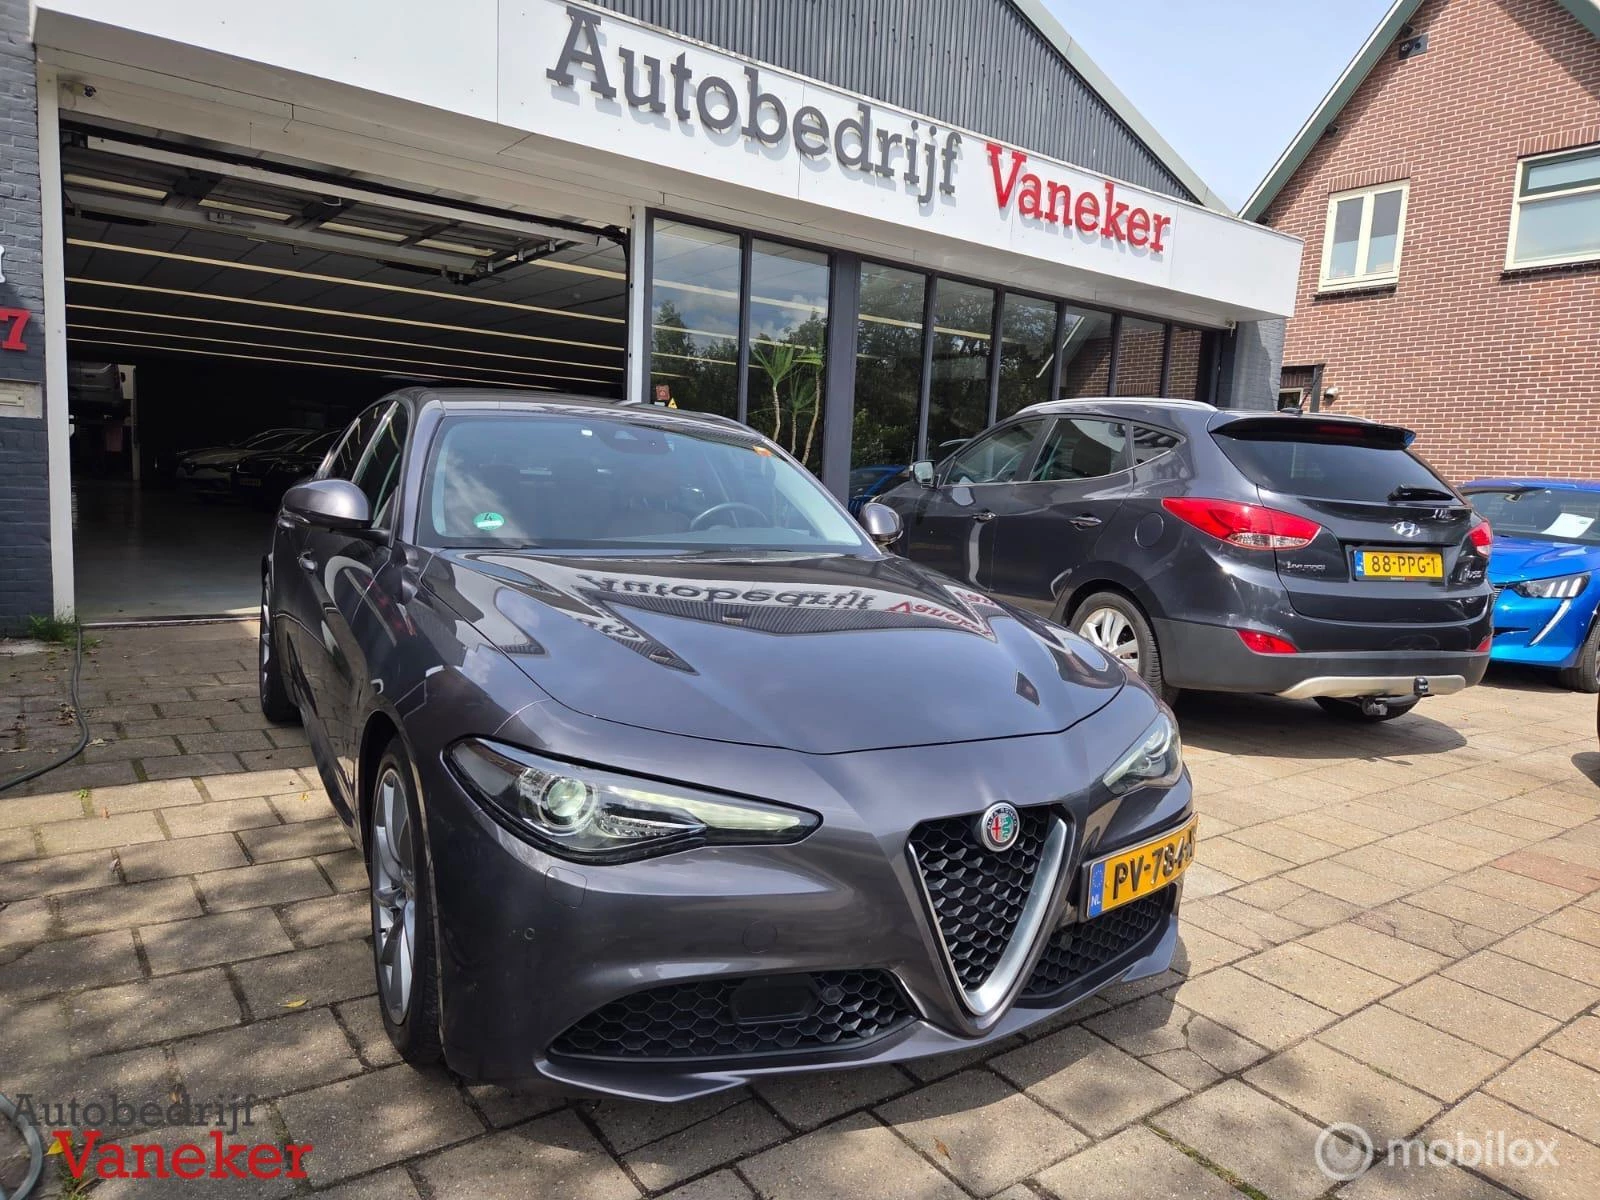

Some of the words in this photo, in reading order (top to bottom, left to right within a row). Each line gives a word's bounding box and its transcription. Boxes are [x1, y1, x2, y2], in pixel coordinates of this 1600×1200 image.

[546, 6, 962, 204] Autobedrijf
[985, 140, 1172, 254] Vaneker
[1371, 555, 1437, 574] 88-PPG-1
